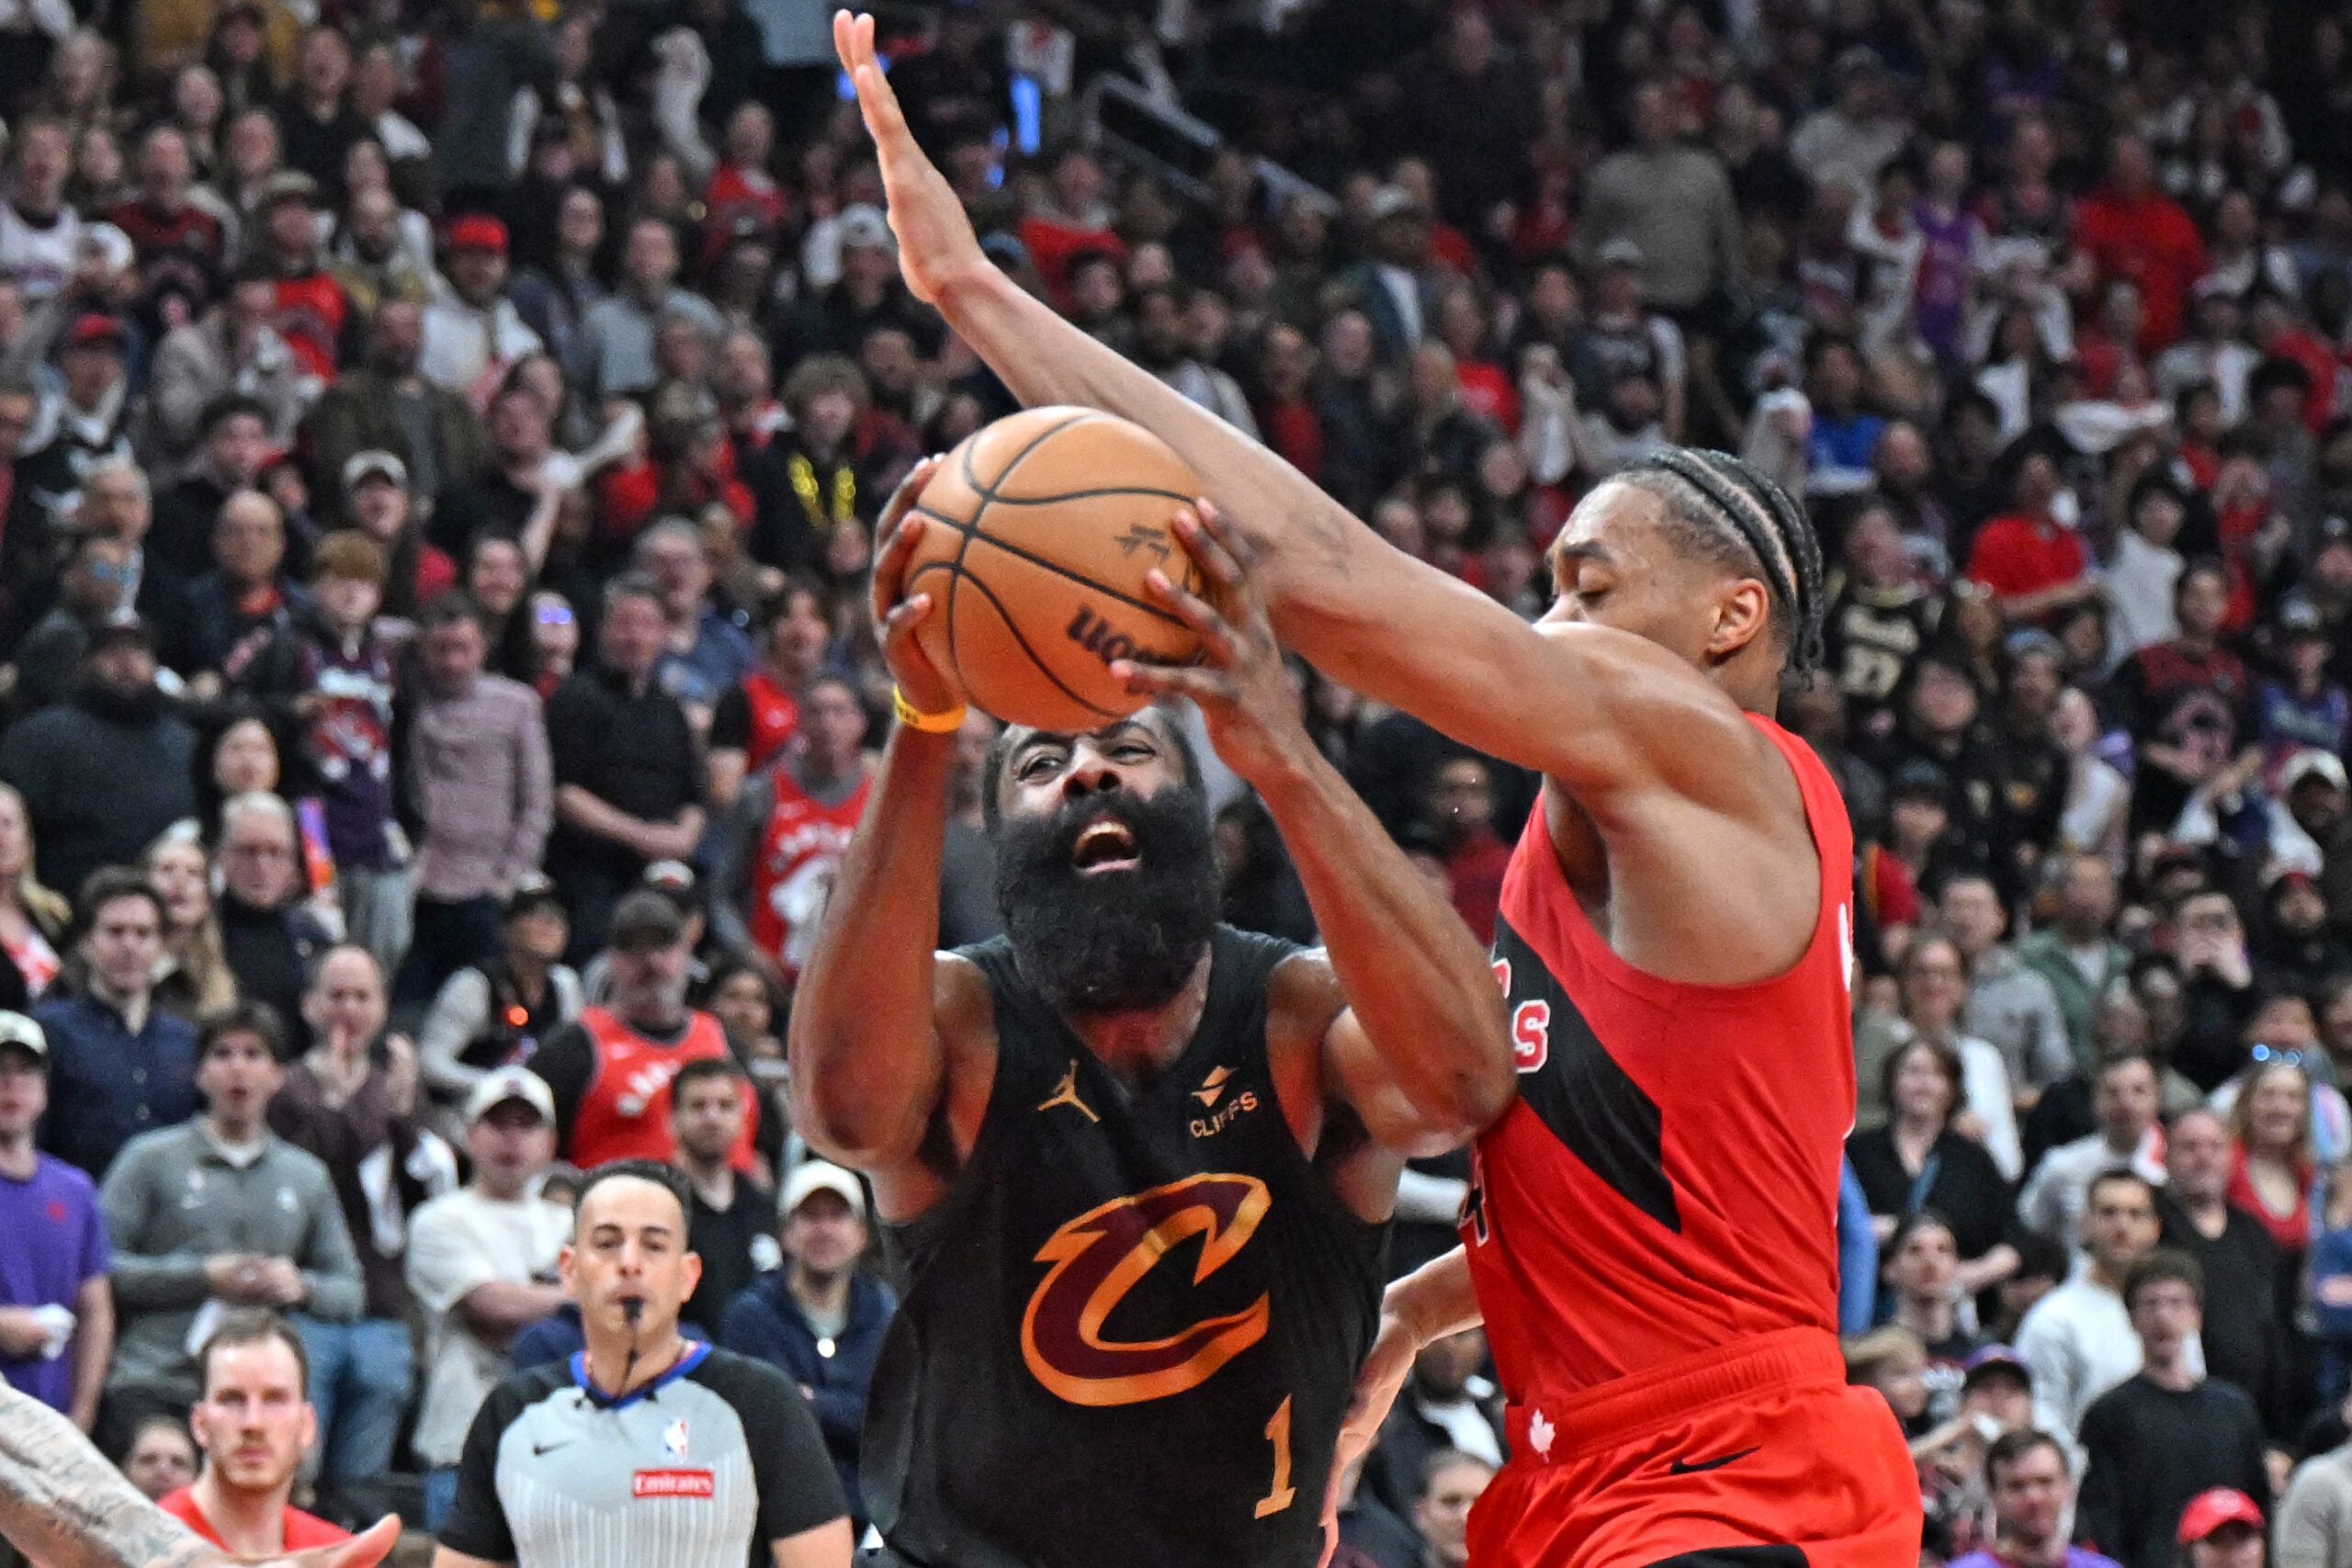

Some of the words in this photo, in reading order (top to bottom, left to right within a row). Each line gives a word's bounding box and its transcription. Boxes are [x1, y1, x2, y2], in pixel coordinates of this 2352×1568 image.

[1191, 1091, 1258, 1138] CLIFFS
[1021, 1173, 1272, 1406] C
[635, 1472, 713, 1495] Emirates
[1254, 1393, 1296, 1519] 1
